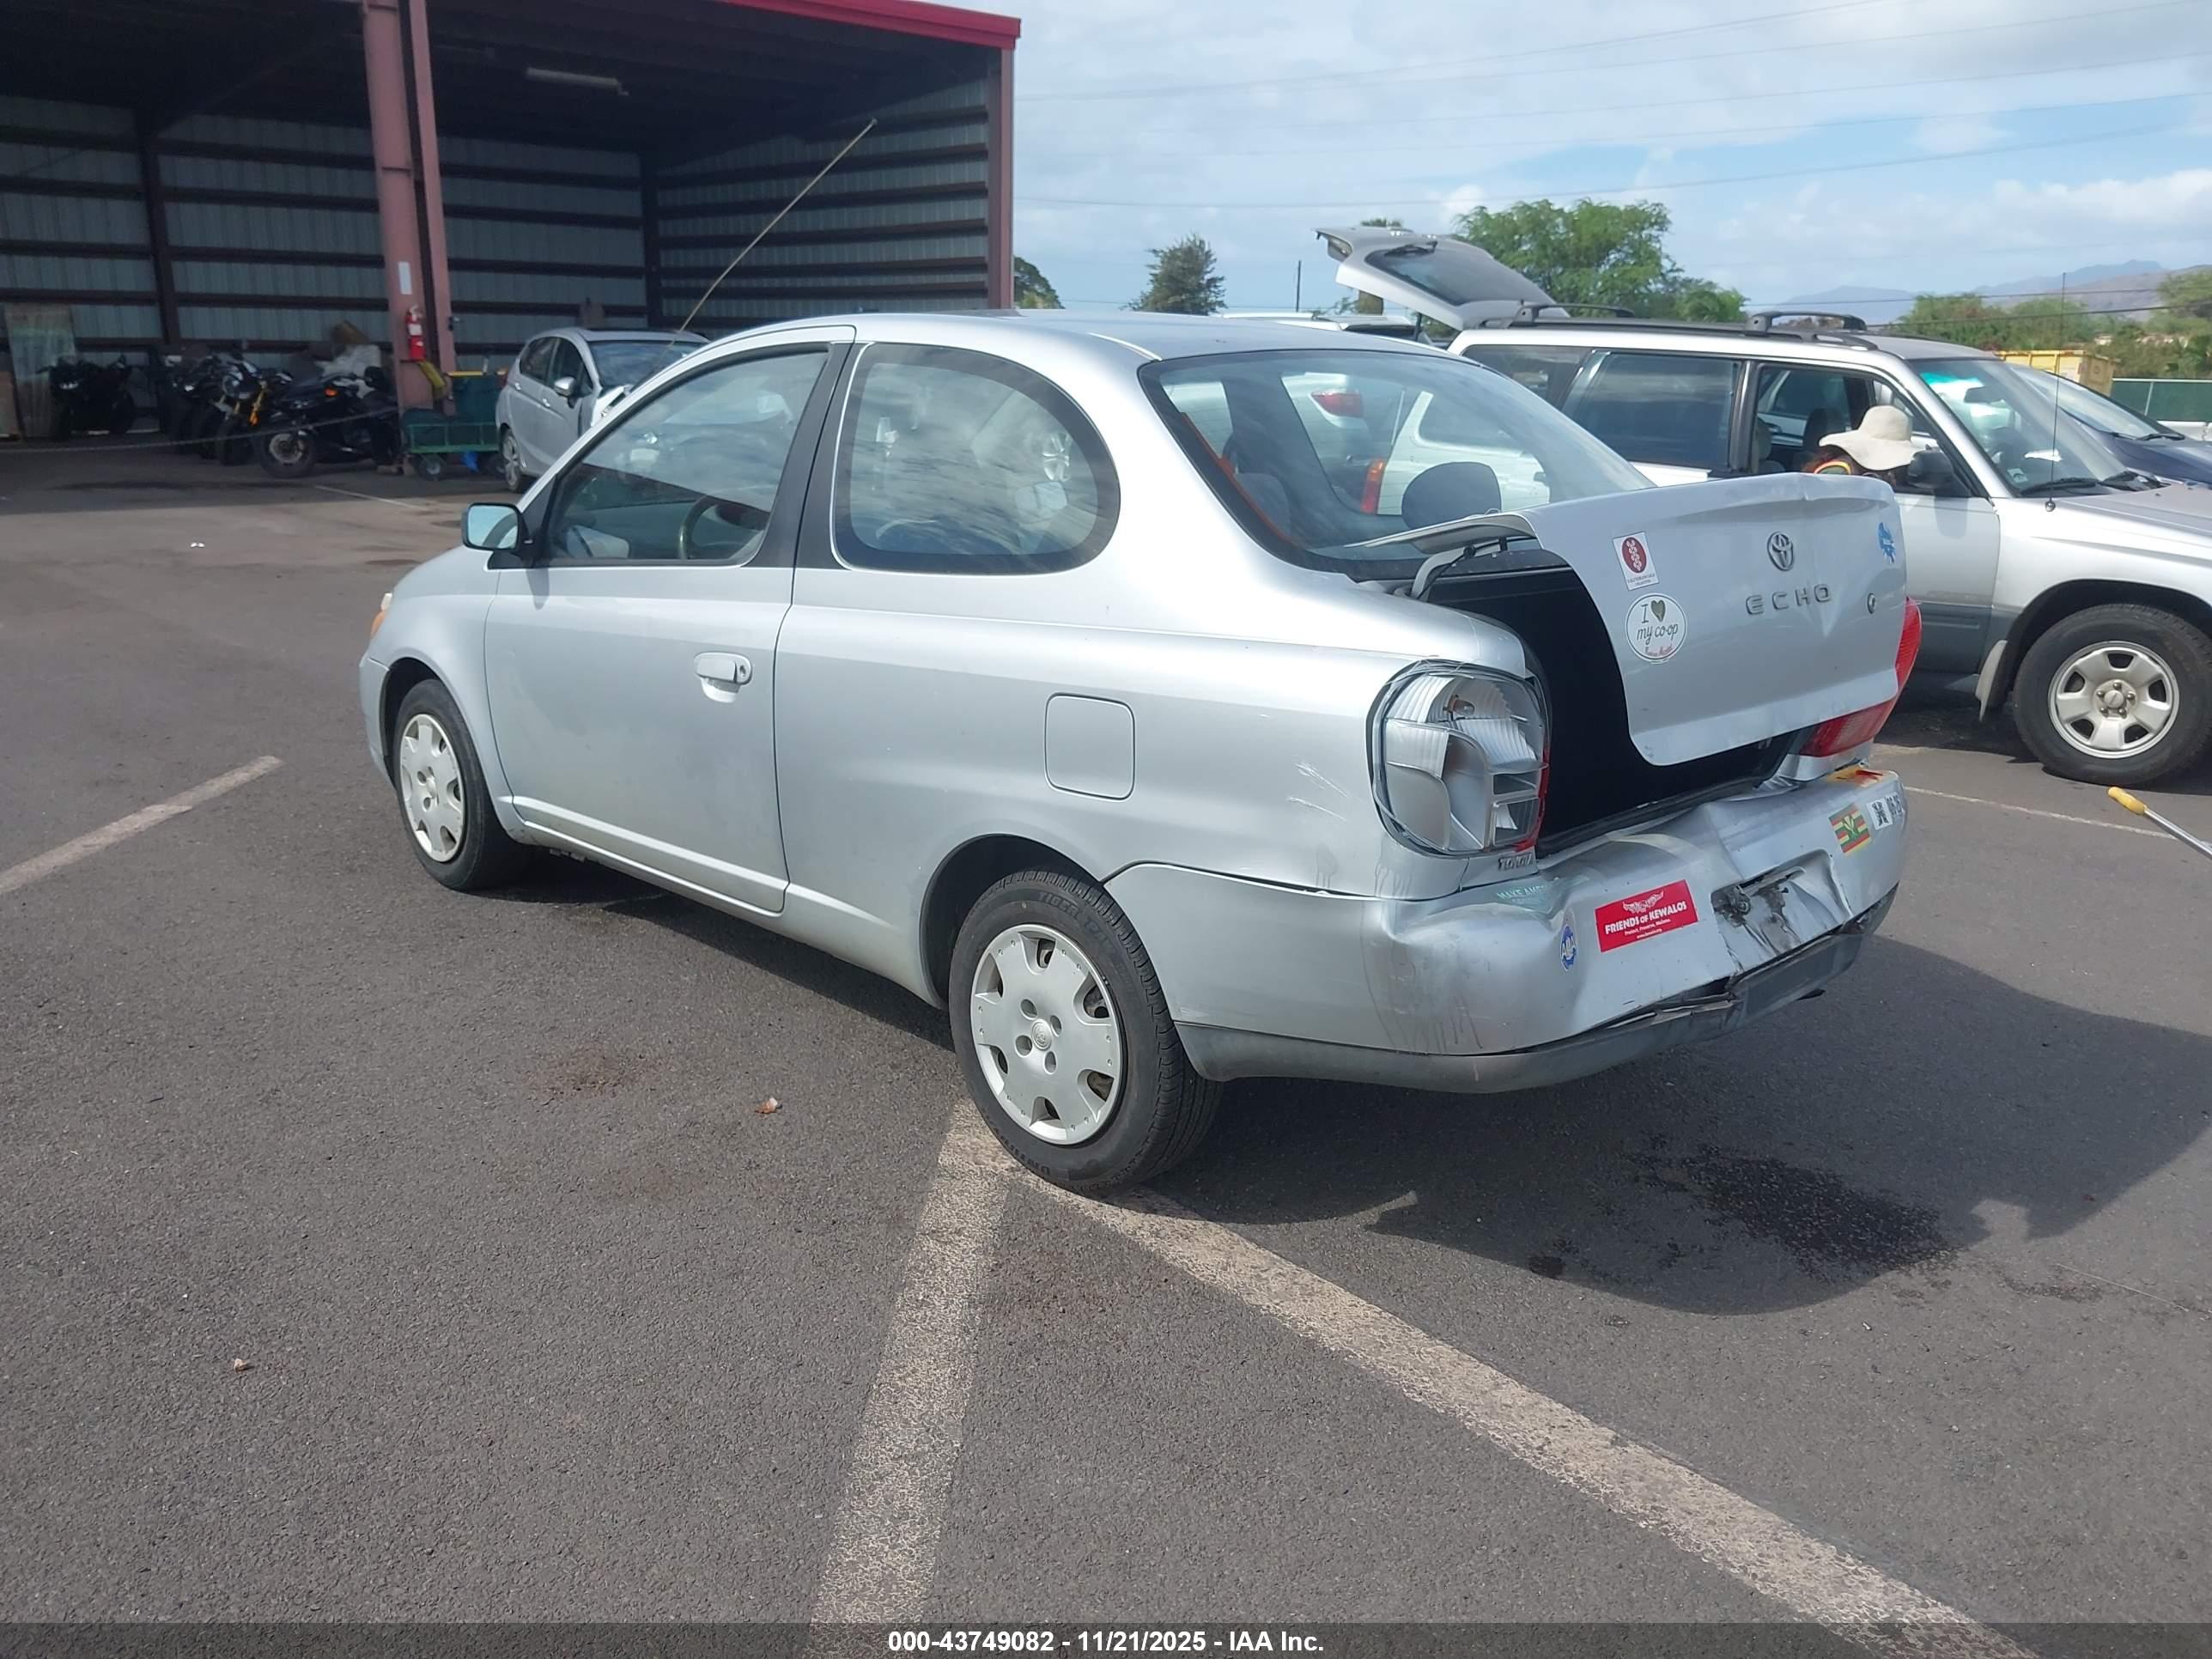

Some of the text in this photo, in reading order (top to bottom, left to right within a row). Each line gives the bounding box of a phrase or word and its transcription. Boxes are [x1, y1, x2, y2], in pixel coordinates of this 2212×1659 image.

[1746, 584, 1831, 615] ECHO
[1641, 604, 1649, 623] I
[1637, 623, 1679, 645] my co-op
[1605, 915, 1640, 934] FRIENDS
[1640, 915, 1649, 923] OF
[1649, 901, 1687, 921] KEWALOS
